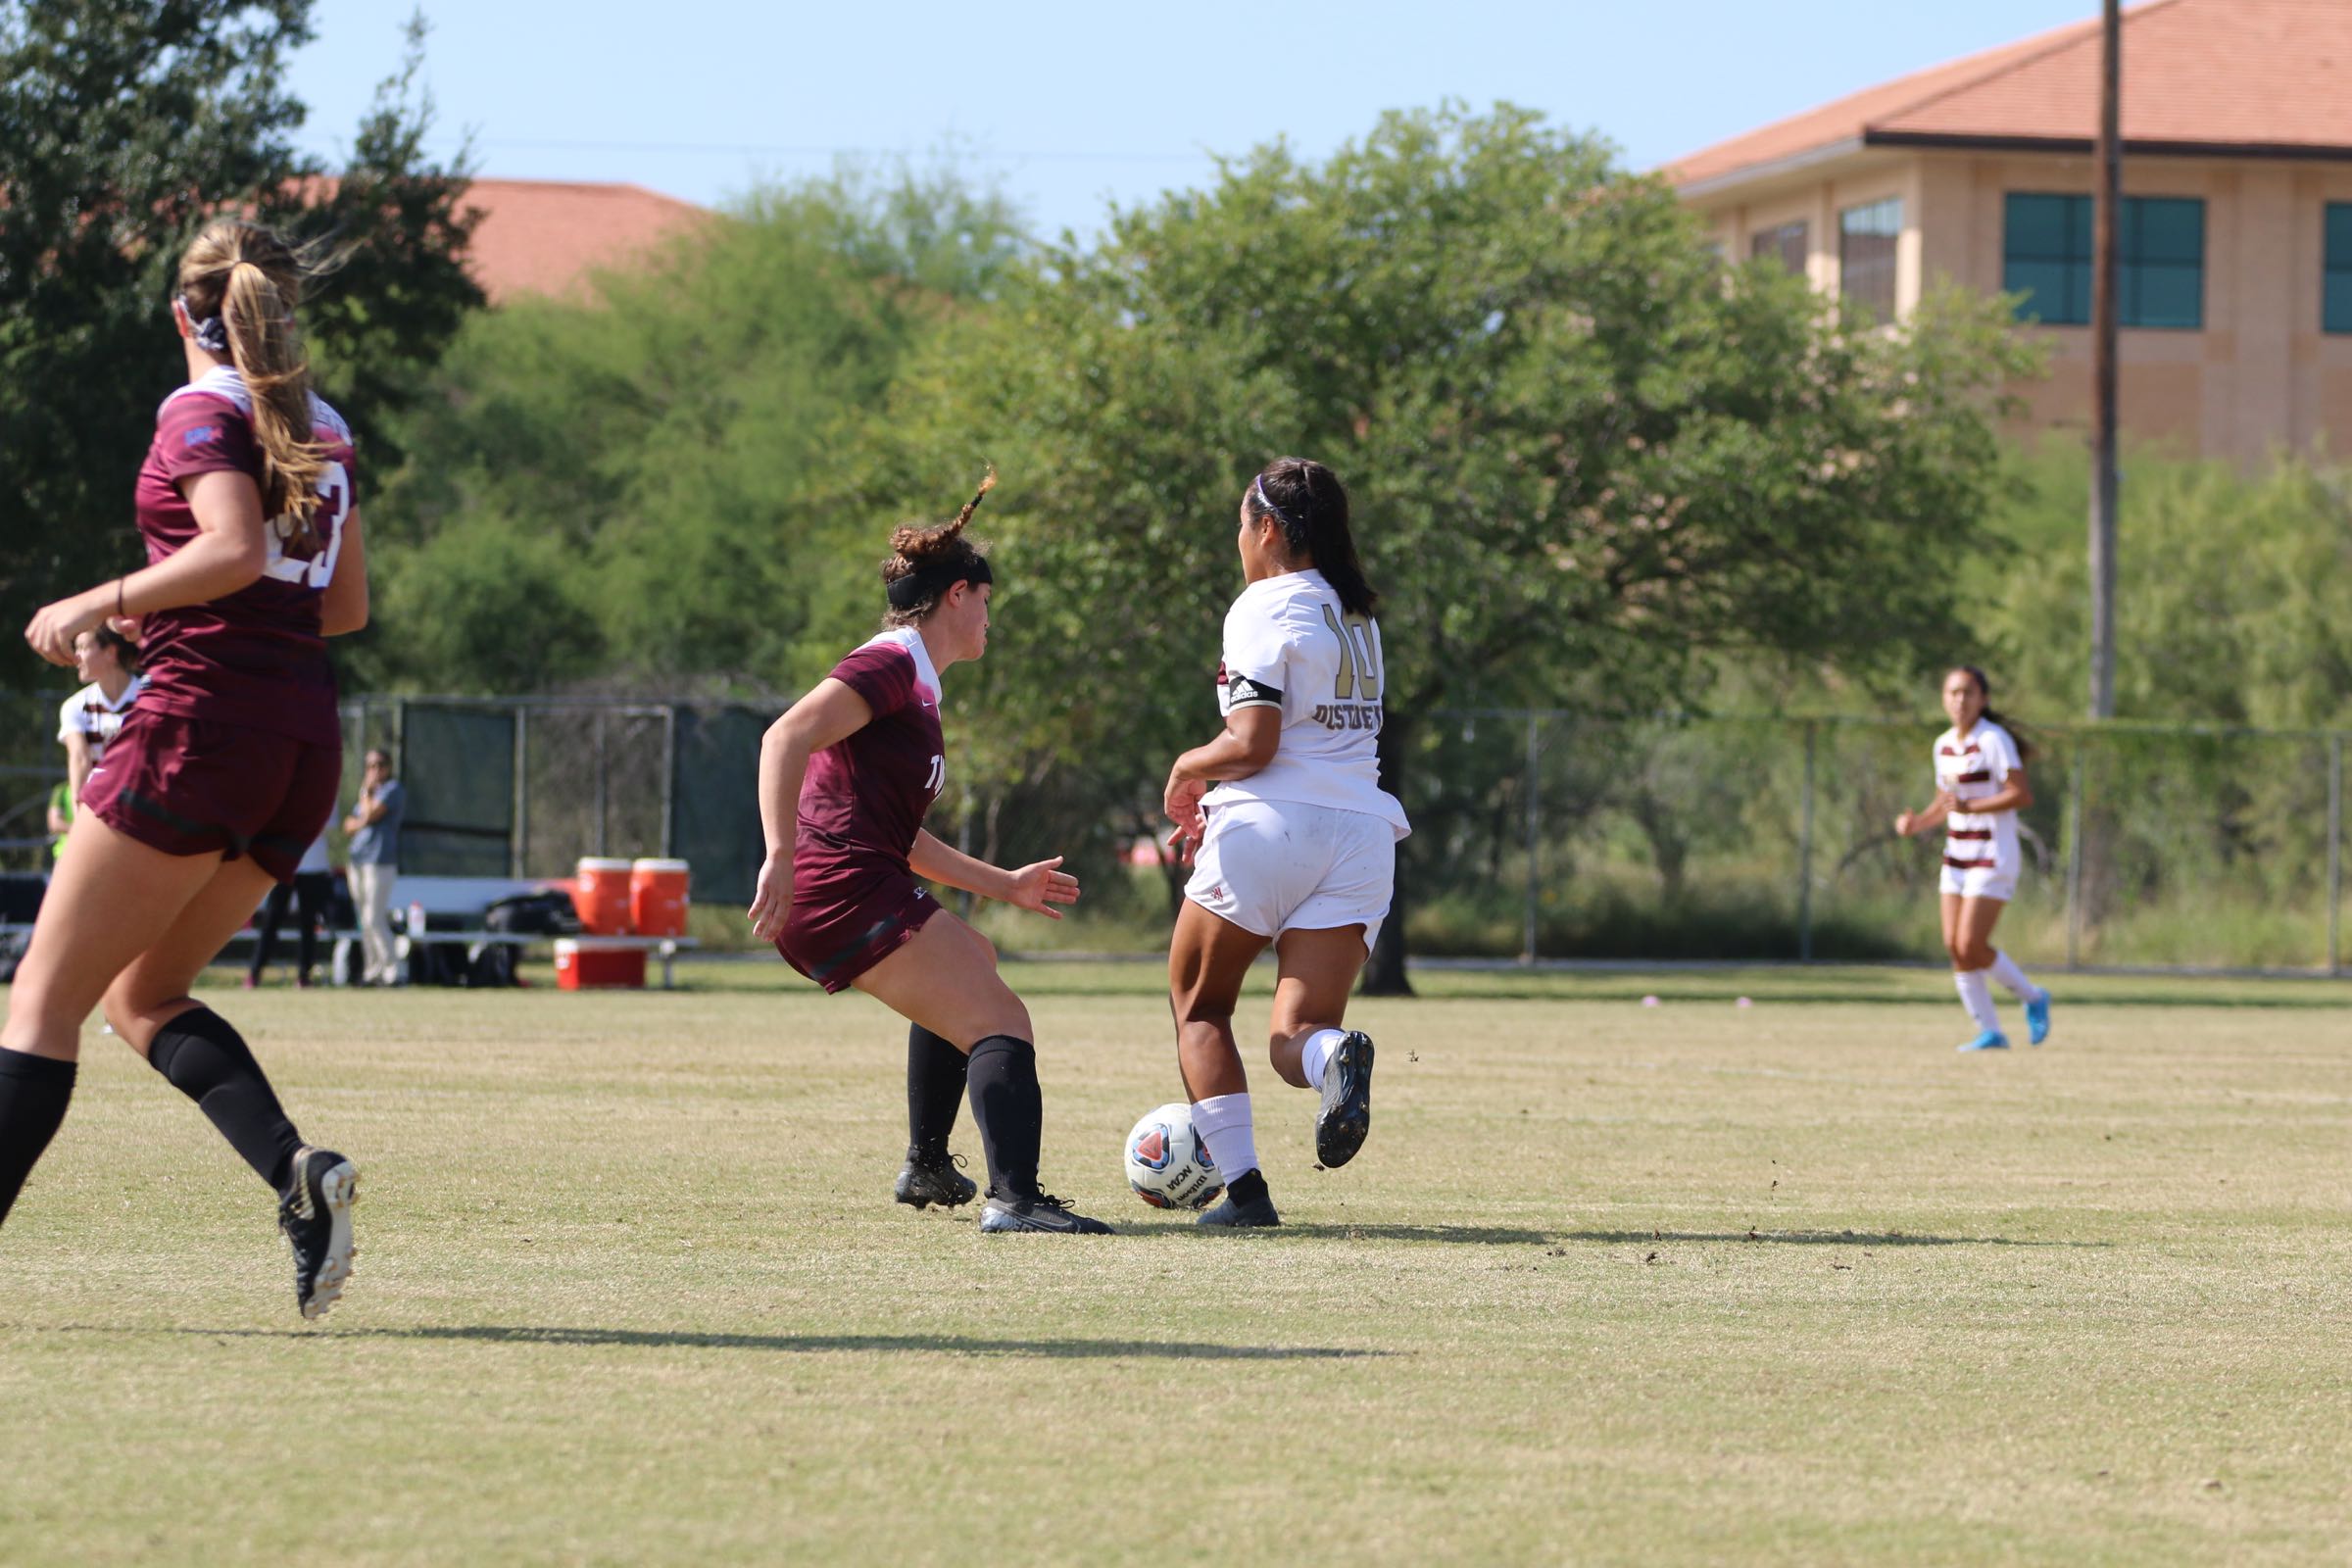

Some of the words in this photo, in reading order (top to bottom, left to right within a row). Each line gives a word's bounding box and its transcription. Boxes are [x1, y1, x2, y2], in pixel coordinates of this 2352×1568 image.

[1321, 603, 1379, 701] 10
[1230, 690, 1259, 703] adidas
[1166, 1165, 1193, 1191] NCAA
[1176, 1175, 1208, 1201] Wilson
